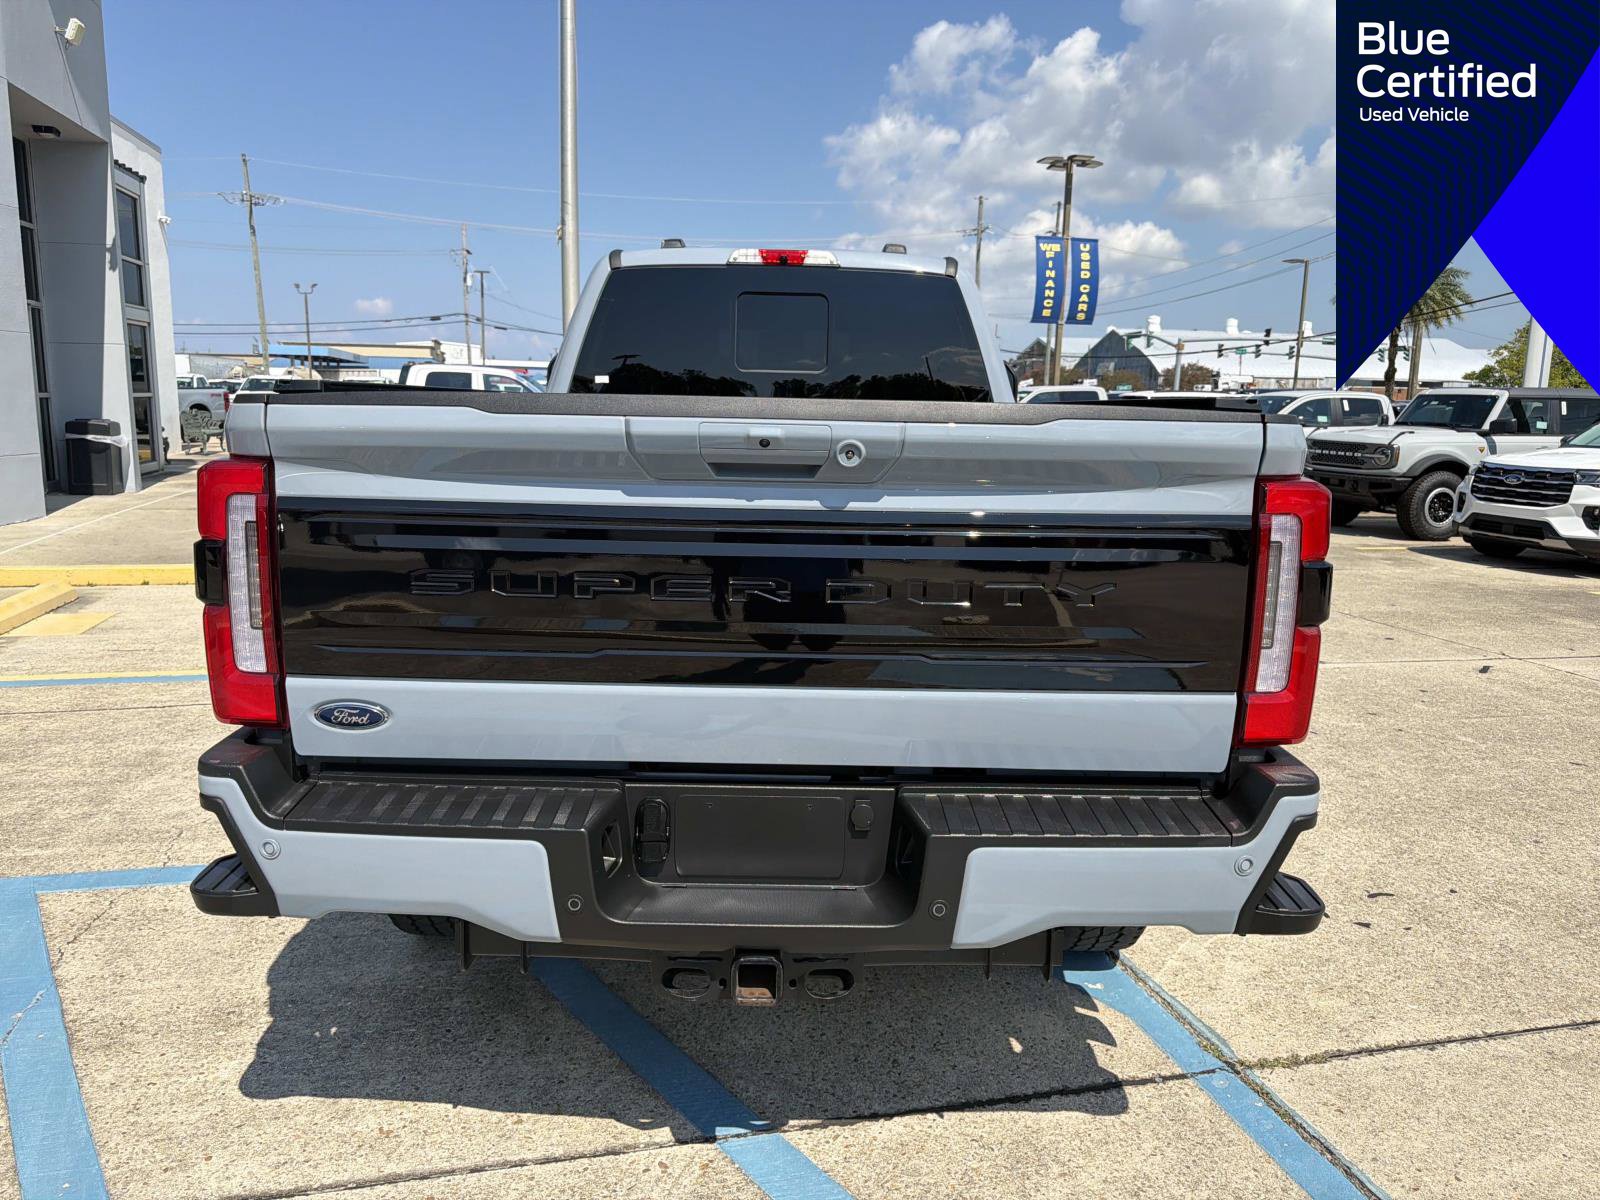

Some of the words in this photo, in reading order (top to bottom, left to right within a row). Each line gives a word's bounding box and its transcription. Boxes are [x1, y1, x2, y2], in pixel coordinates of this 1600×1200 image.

[1039, 243, 1061, 252] WE
[1079, 243, 1091, 279] USED
[1042, 251, 1056, 317] FINANCE
[1075, 284, 1091, 320] CARS
[408, 568, 793, 602] SUPER
[825, 579, 1118, 608] DUTY
[331, 708, 370, 724] Ford
